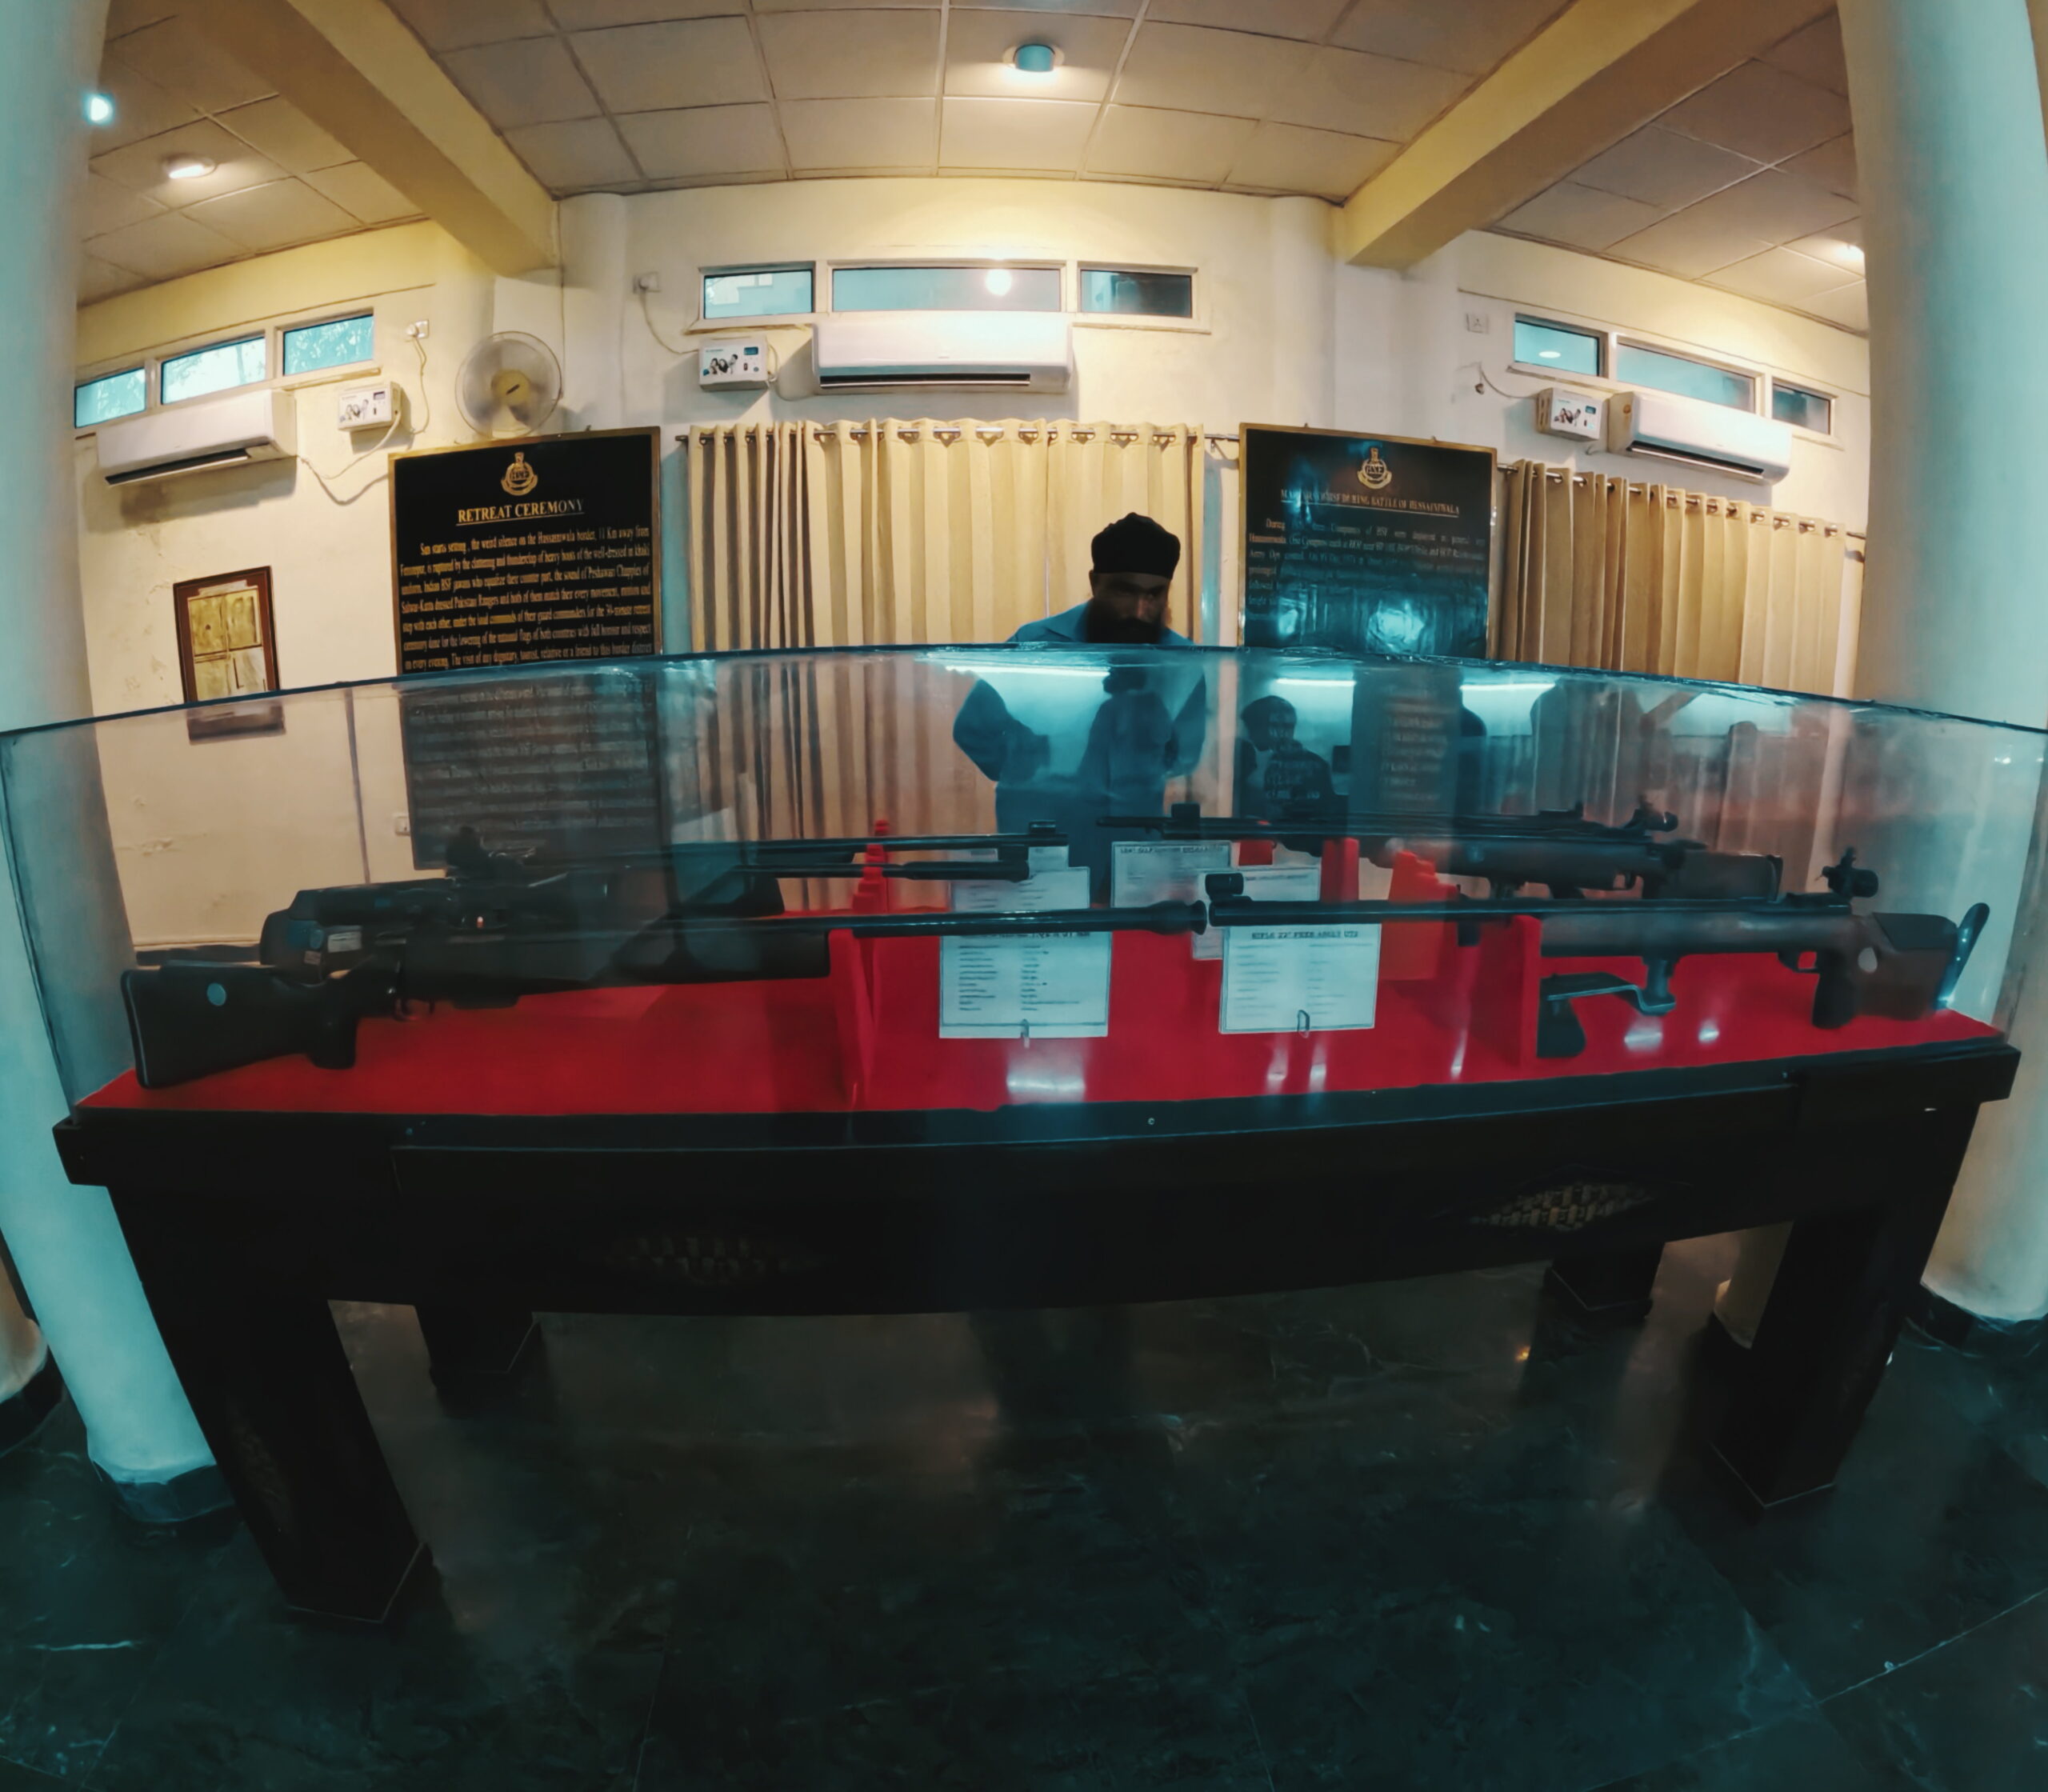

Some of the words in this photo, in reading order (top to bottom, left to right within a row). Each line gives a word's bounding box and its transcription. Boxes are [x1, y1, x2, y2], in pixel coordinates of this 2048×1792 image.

[458, 505, 512, 522] RETREAT
[514, 499, 584, 517] CEREMONY
[1371, 497, 1397, 508] BATTLE
